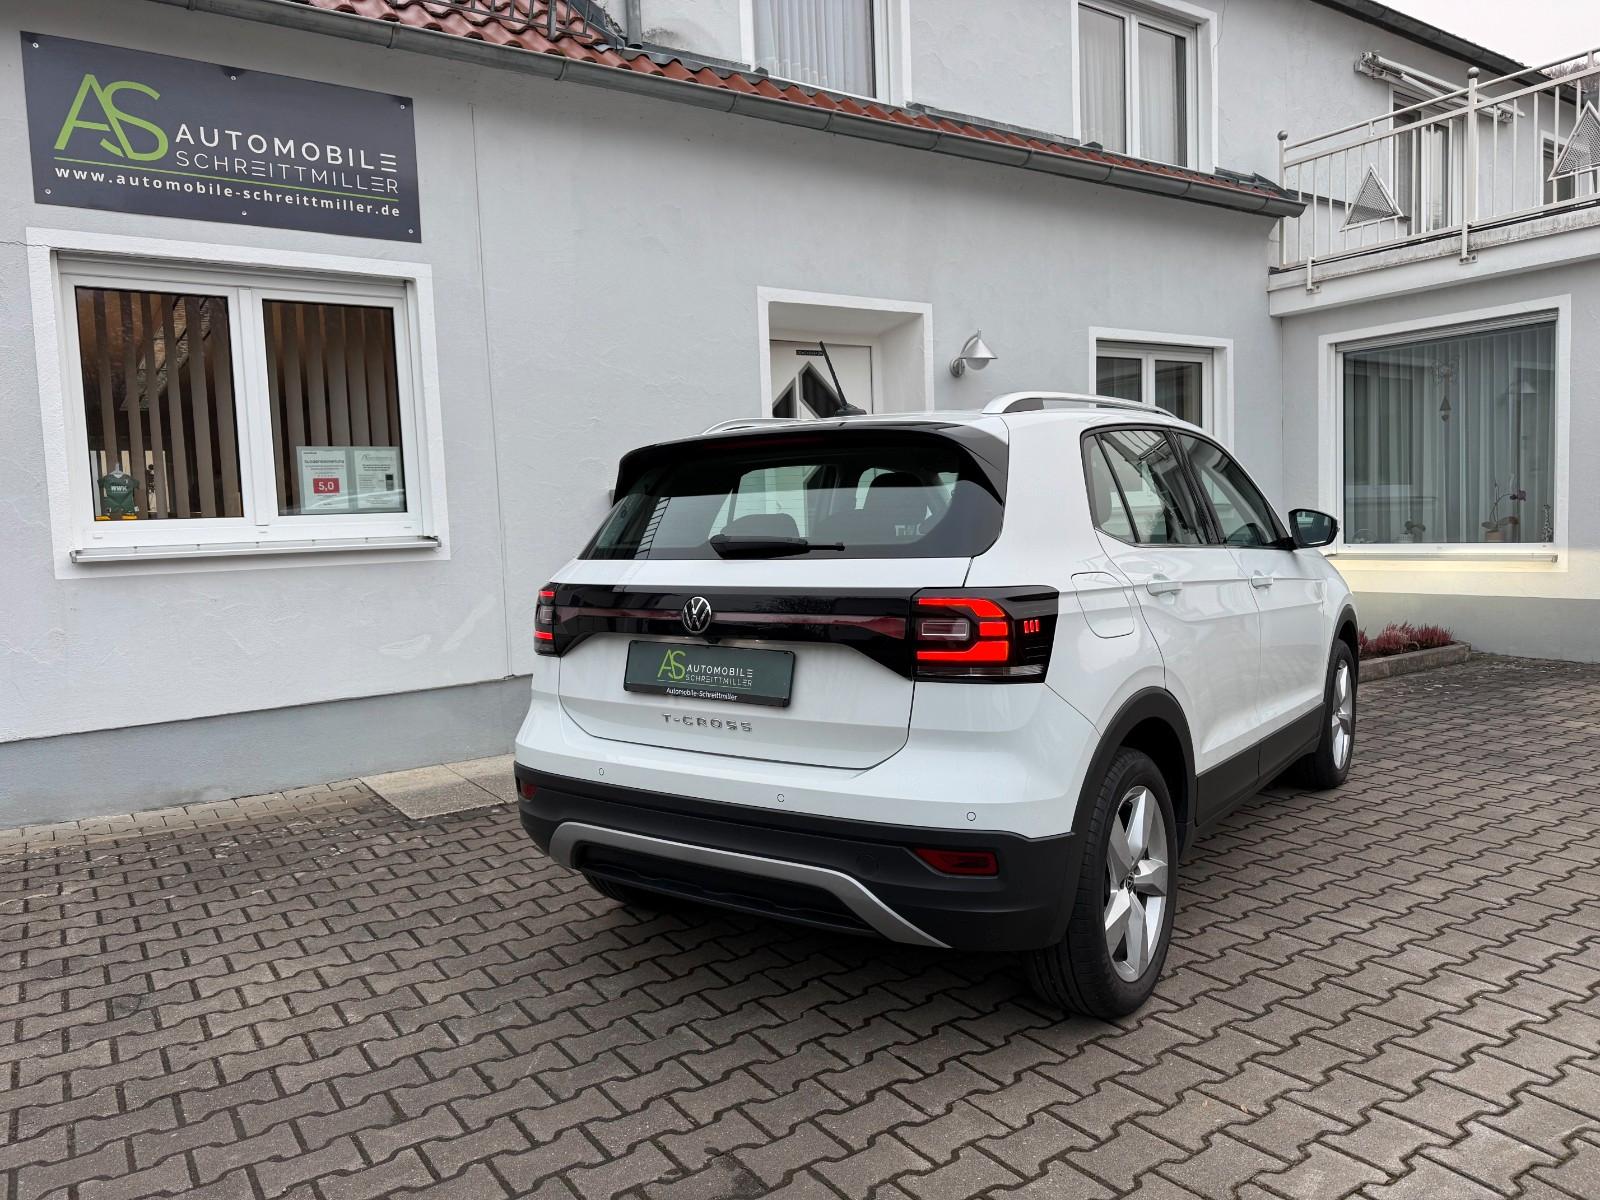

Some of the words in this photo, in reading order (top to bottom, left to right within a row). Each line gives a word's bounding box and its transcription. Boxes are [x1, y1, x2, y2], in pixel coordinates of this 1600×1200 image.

[54, 74, 169, 161] AS
[175, 123, 398, 173] AUTOMOBILE
[176, 150, 399, 194] SCHREITTMILLER
[55, 167, 400, 217] www.automobile-schreittmiller.de
[318, 481, 335, 491] 5,0
[657, 649, 687, 680] AS
[686, 664, 753, 678] AUTOMOBILE
[685, 674, 753, 687] SCHREITTMILLER
[662, 713, 753, 732] T-CROSS
